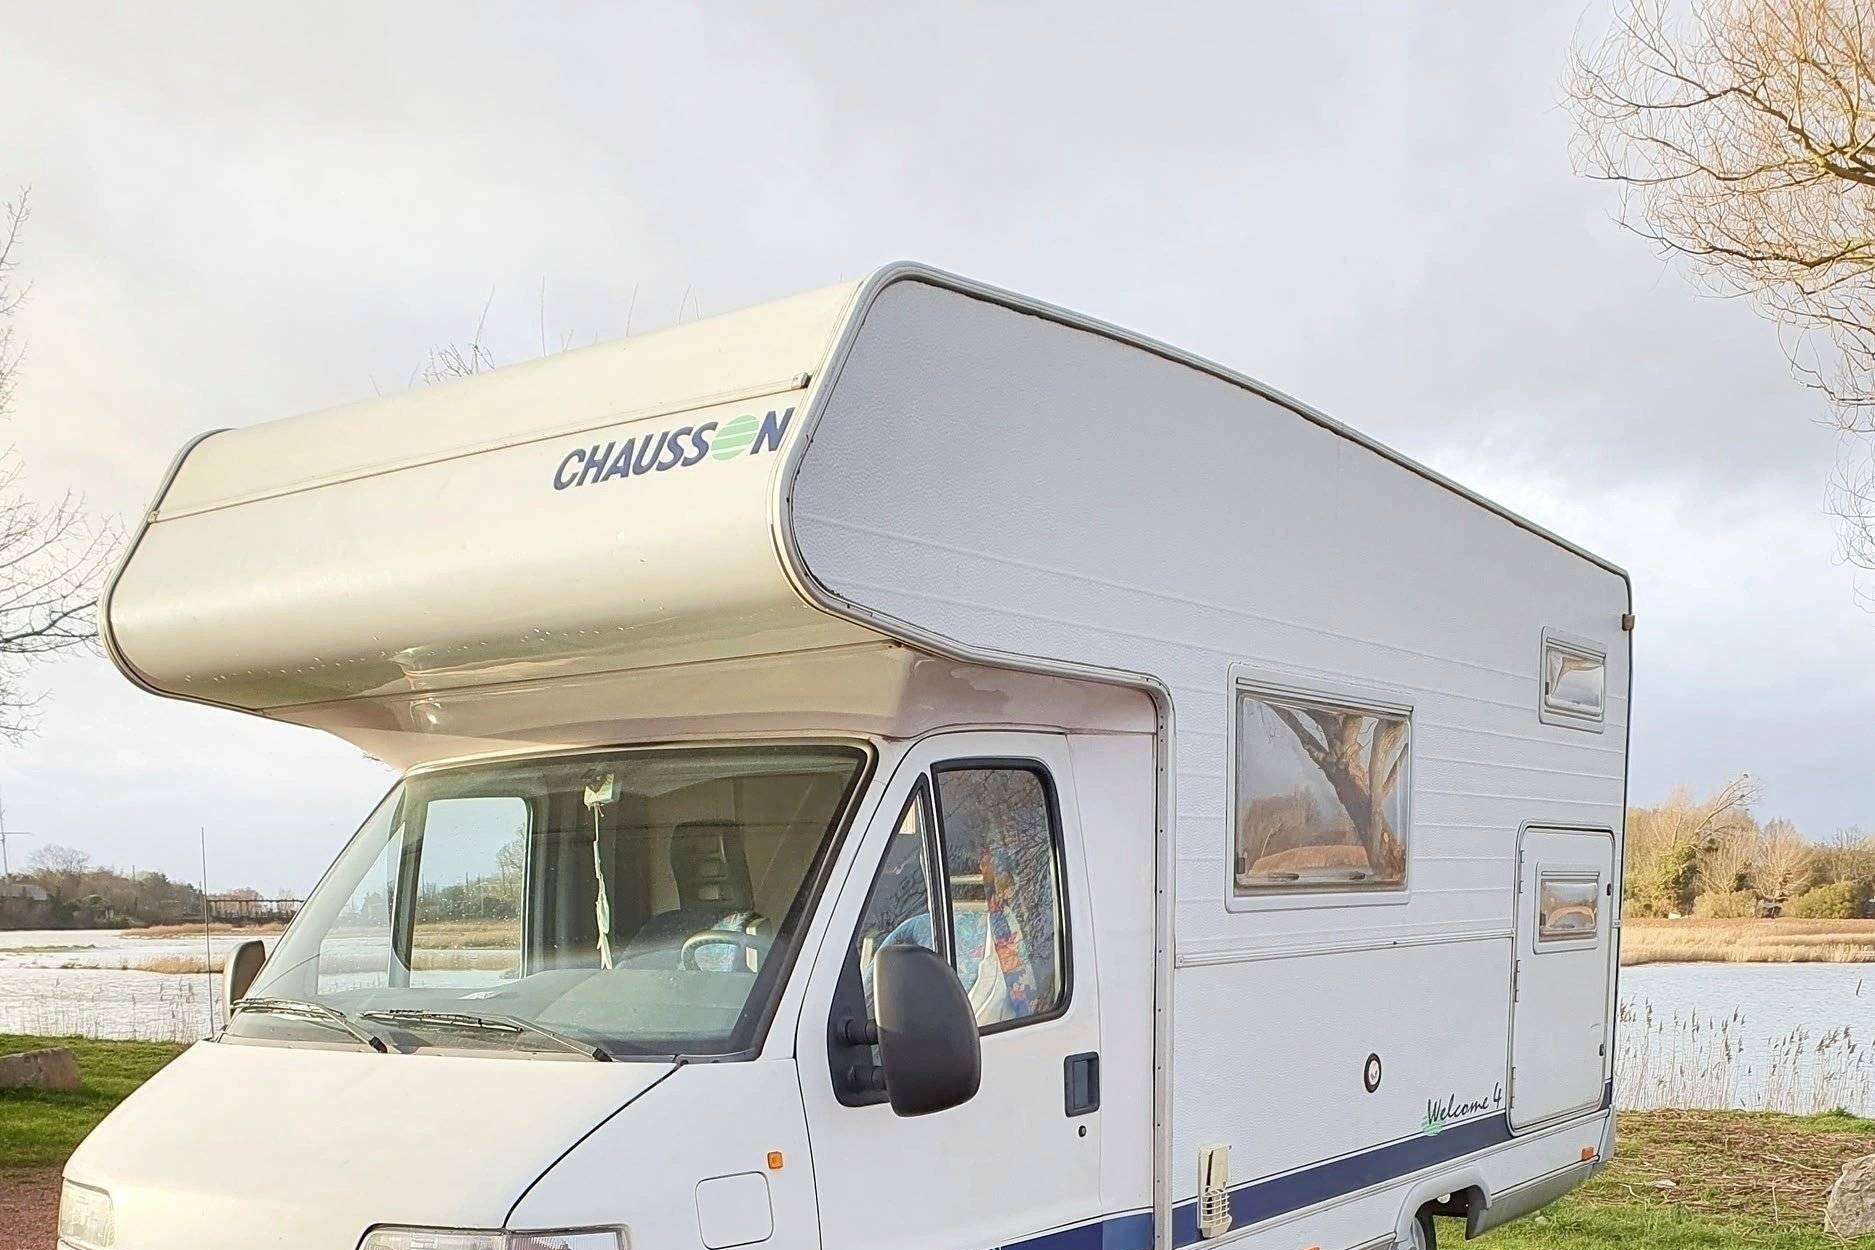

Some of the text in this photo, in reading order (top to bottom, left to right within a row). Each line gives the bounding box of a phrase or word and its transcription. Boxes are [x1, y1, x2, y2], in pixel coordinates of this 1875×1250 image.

[553, 406, 796, 491] CHAUSSON
[1427, 1081, 1502, 1126] Welcome 4
